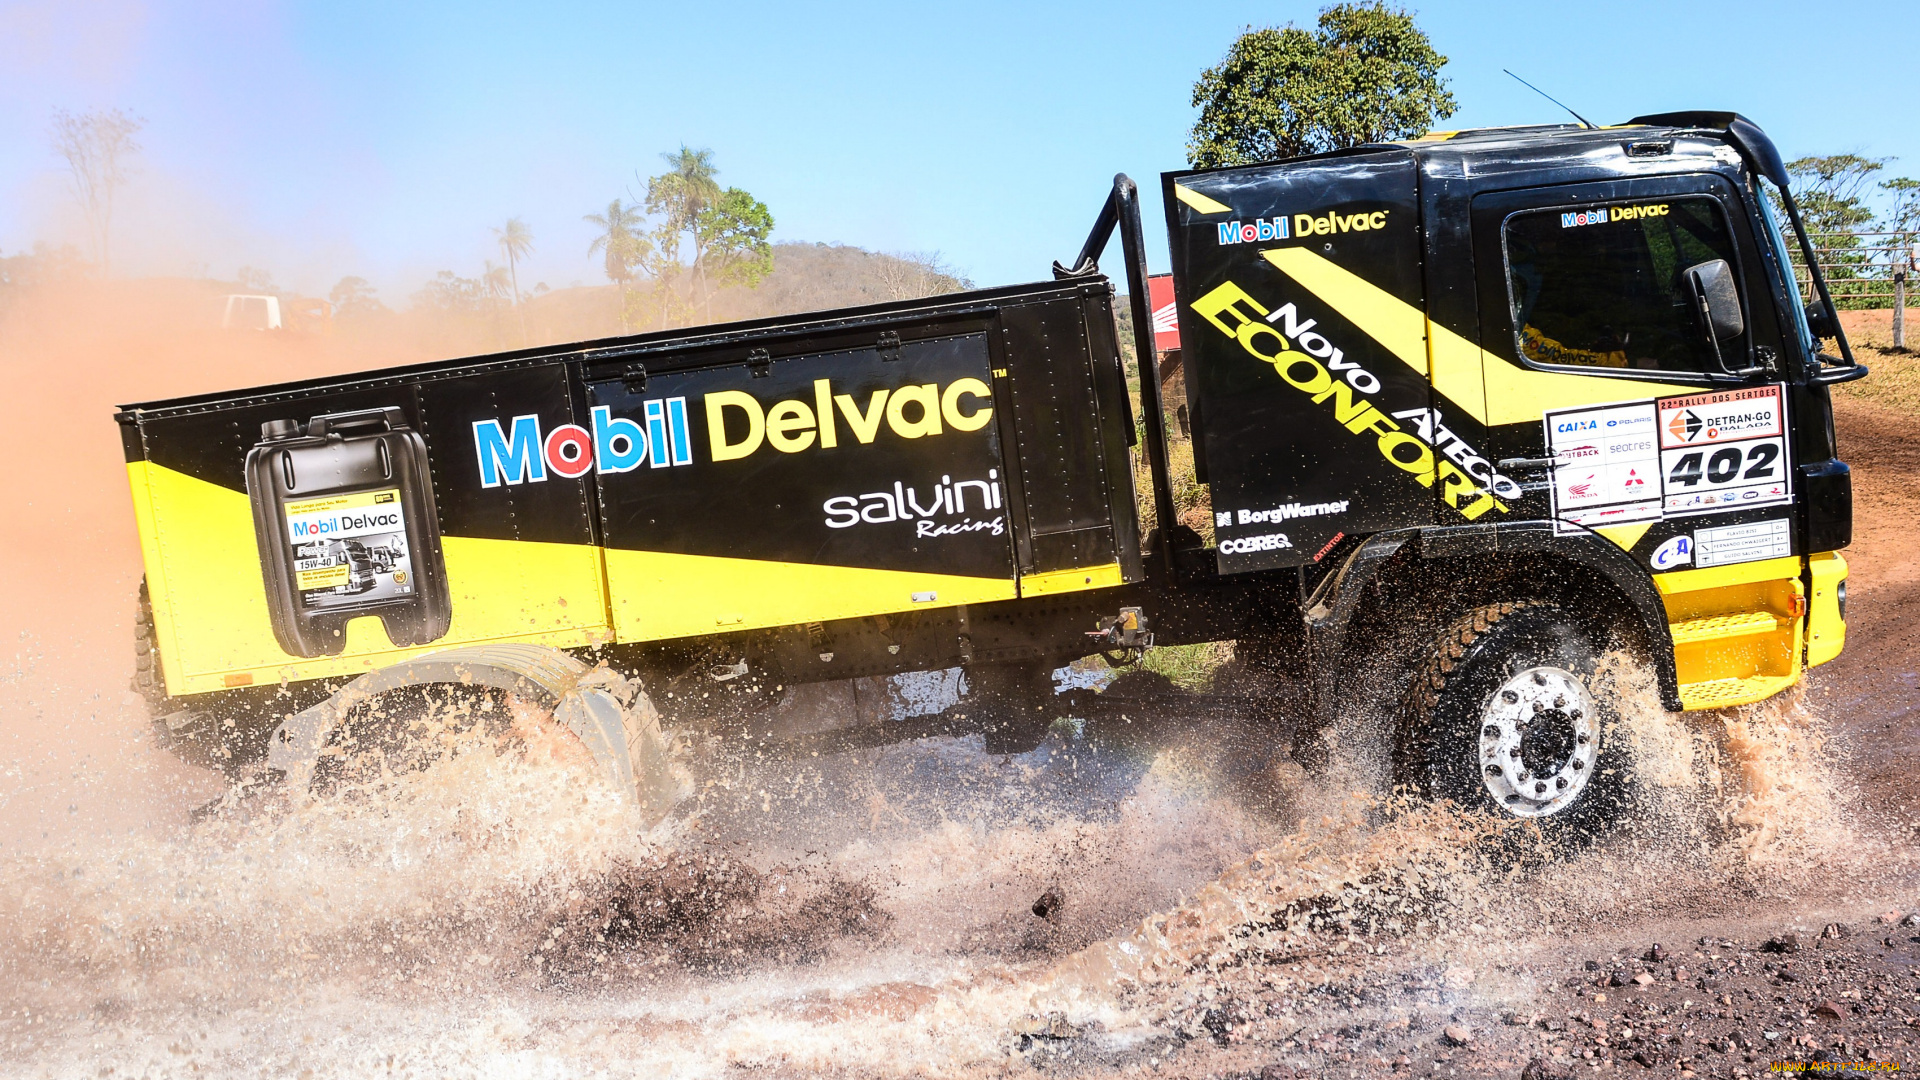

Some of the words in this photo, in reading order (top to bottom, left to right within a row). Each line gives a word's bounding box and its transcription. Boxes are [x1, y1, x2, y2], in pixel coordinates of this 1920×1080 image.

[1561, 207, 1608, 229] Mobil
[1610, 203, 1669, 222] Delvac
[1217, 215, 1290, 246] Mobil
[1293, 210, 1387, 238] Delvac
[1189, 280, 1510, 521] ECONFORT
[1712, 393, 1730, 403] DOS
[1735, 387, 1777, 400] SERTÕES
[1557, 420, 1598, 433] CAIXA
[1618, 416, 1652, 425] POLARIS
[1707, 411, 1772, 427] DETRAN-GO
[1719, 421, 1772, 432] BALADA
[472, 396, 693, 489] Mobil
[703, 377, 995, 463] Delvac
[1668, 442, 1780, 487] 402
[823, 468, 1002, 529] salvini
[1569, 492, 1598, 500] HONDA
[1237, 500, 1350, 525] BorgWarner
[293, 517, 338, 537] Mobil
[341, 513, 398, 531] Delvac
[916, 516, 1005, 539] Racing
[1219, 533, 1293, 555] COBREQ
[1312, 531, 1345, 562] EXTINTOR
[300, 557, 332, 570] 15W-40
